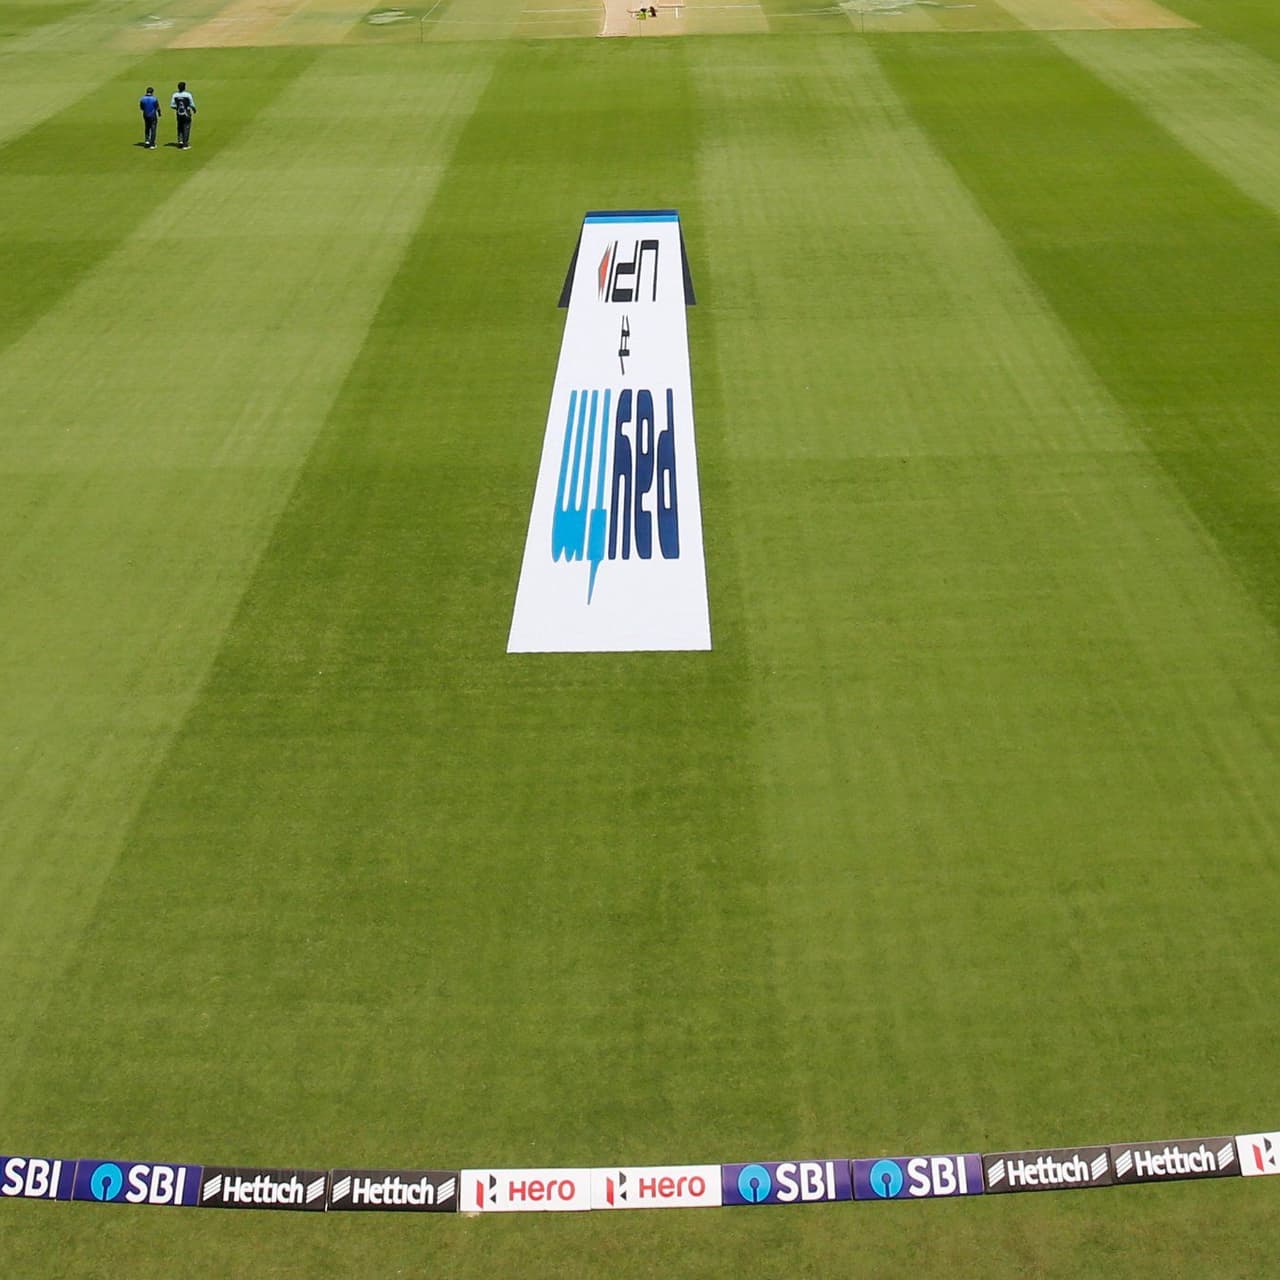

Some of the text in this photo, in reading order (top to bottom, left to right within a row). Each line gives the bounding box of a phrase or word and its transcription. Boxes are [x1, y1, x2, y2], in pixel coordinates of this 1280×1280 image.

[1007, 1156, 1090, 1187] Hettich
[1134, 1144, 1217, 1178] Hettich
[1, 1158, 59, 1198] SBI
[125, 1164, 185, 1204] SBI
[222, 1175, 305, 1205] Hettich
[352, 1175, 435, 1206] Hettich
[508, 1178, 576, 1202] Hero
[638, 1175, 706, 1198] Hero
[776, 1162, 836, 1202] SBI
[908, 1157, 967, 1198] SBI
